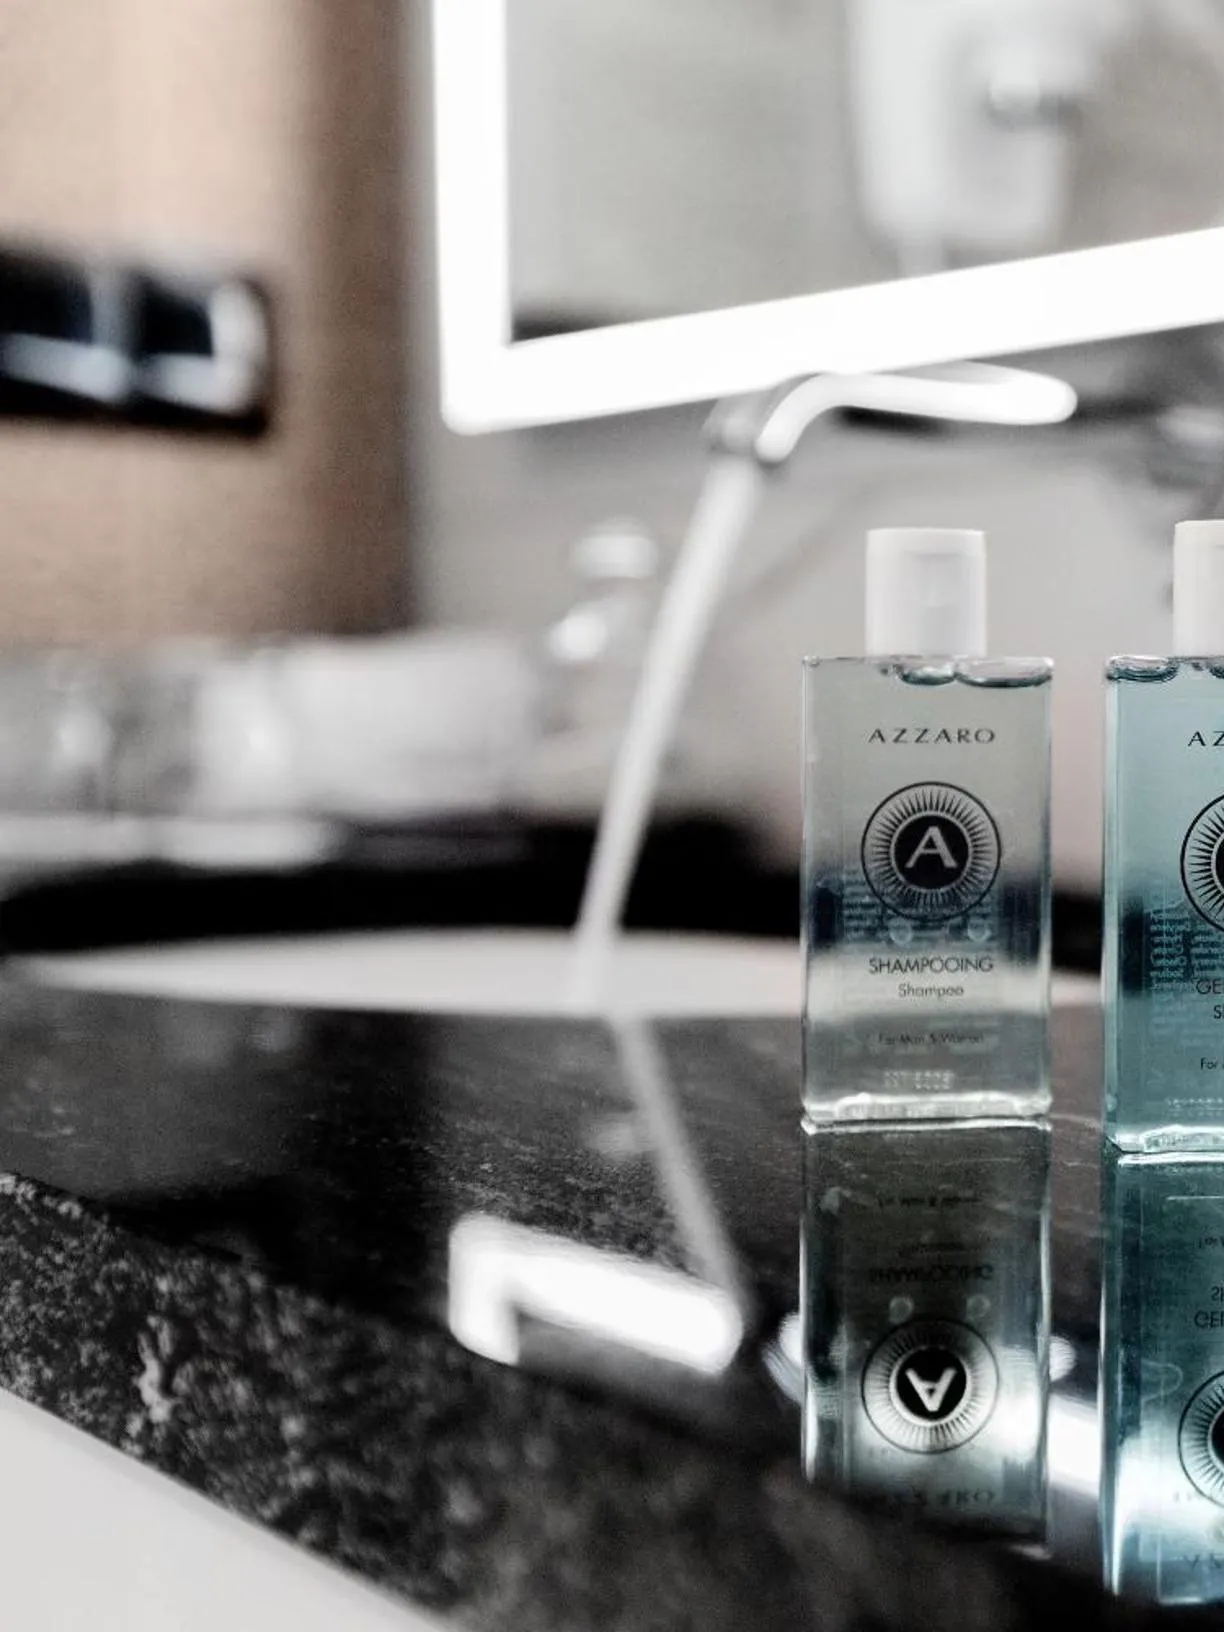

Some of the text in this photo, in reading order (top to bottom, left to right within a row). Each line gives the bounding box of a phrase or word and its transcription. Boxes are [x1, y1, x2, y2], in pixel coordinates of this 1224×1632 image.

[868, 727, 996, 744] AZZARO
[905, 825, 957, 868] A
[868, 956, 995, 975] SHAMPOOING
[898, 983, 965, 998] Shampoo
[1200, 1057, 1218, 1070] For
